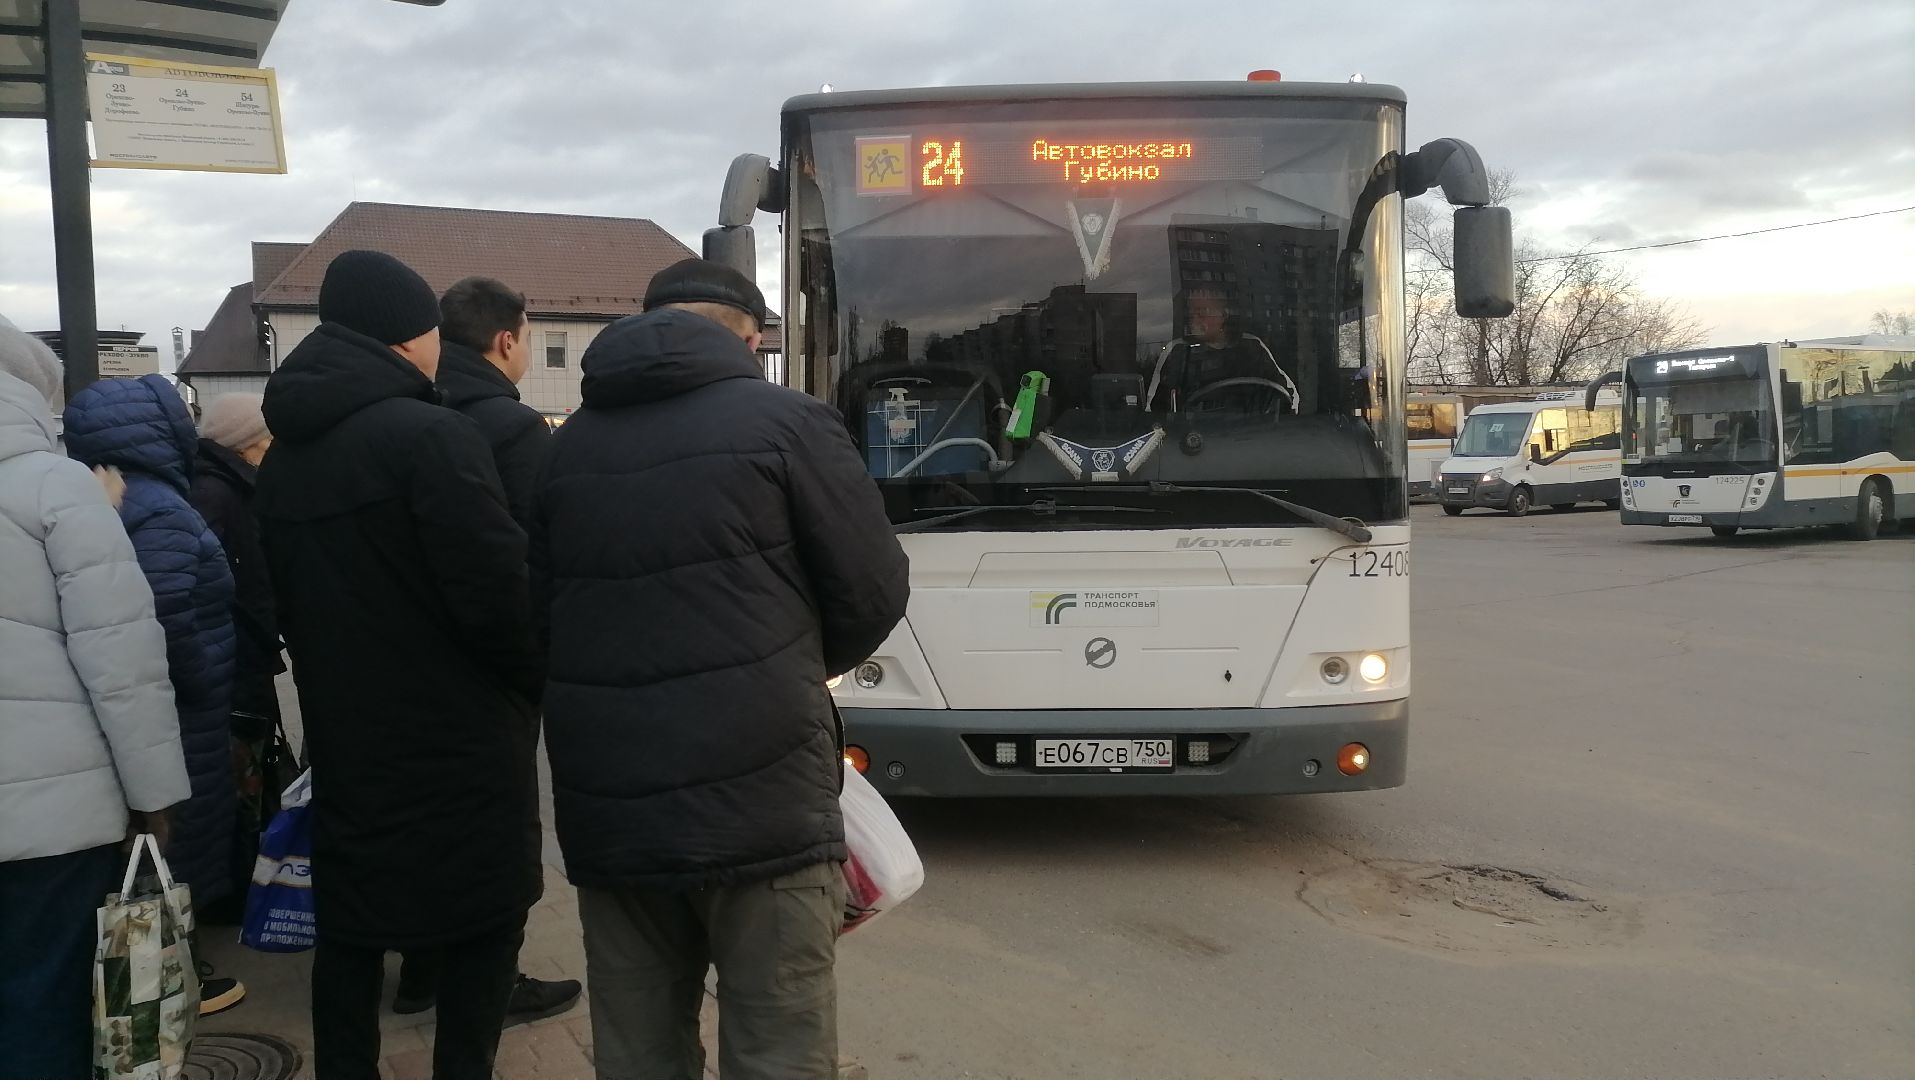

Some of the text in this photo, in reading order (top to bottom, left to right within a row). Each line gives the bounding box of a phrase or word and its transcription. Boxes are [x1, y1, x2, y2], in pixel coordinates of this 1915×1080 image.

[112, 83, 126, 93] 23
[175, 88, 189, 97] 24
[241, 92, 254, 102] 54
[1032, 139, 1192, 161] Автовокзал
[922, 141, 964, 186] 24
[1063, 160, 1160, 184] Губино
[1061, 443, 1083, 467] SCANIA
[1123, 439, 1146, 463] SCANIA
[1084, 592, 1140, 600] ТРАНСПОРТ
[1084, 601, 1156, 609] ПОДМОСКОВЬЯ
[1134, 741, 1167, 757] 750
[1141, 757, 1158, 765] RUS
